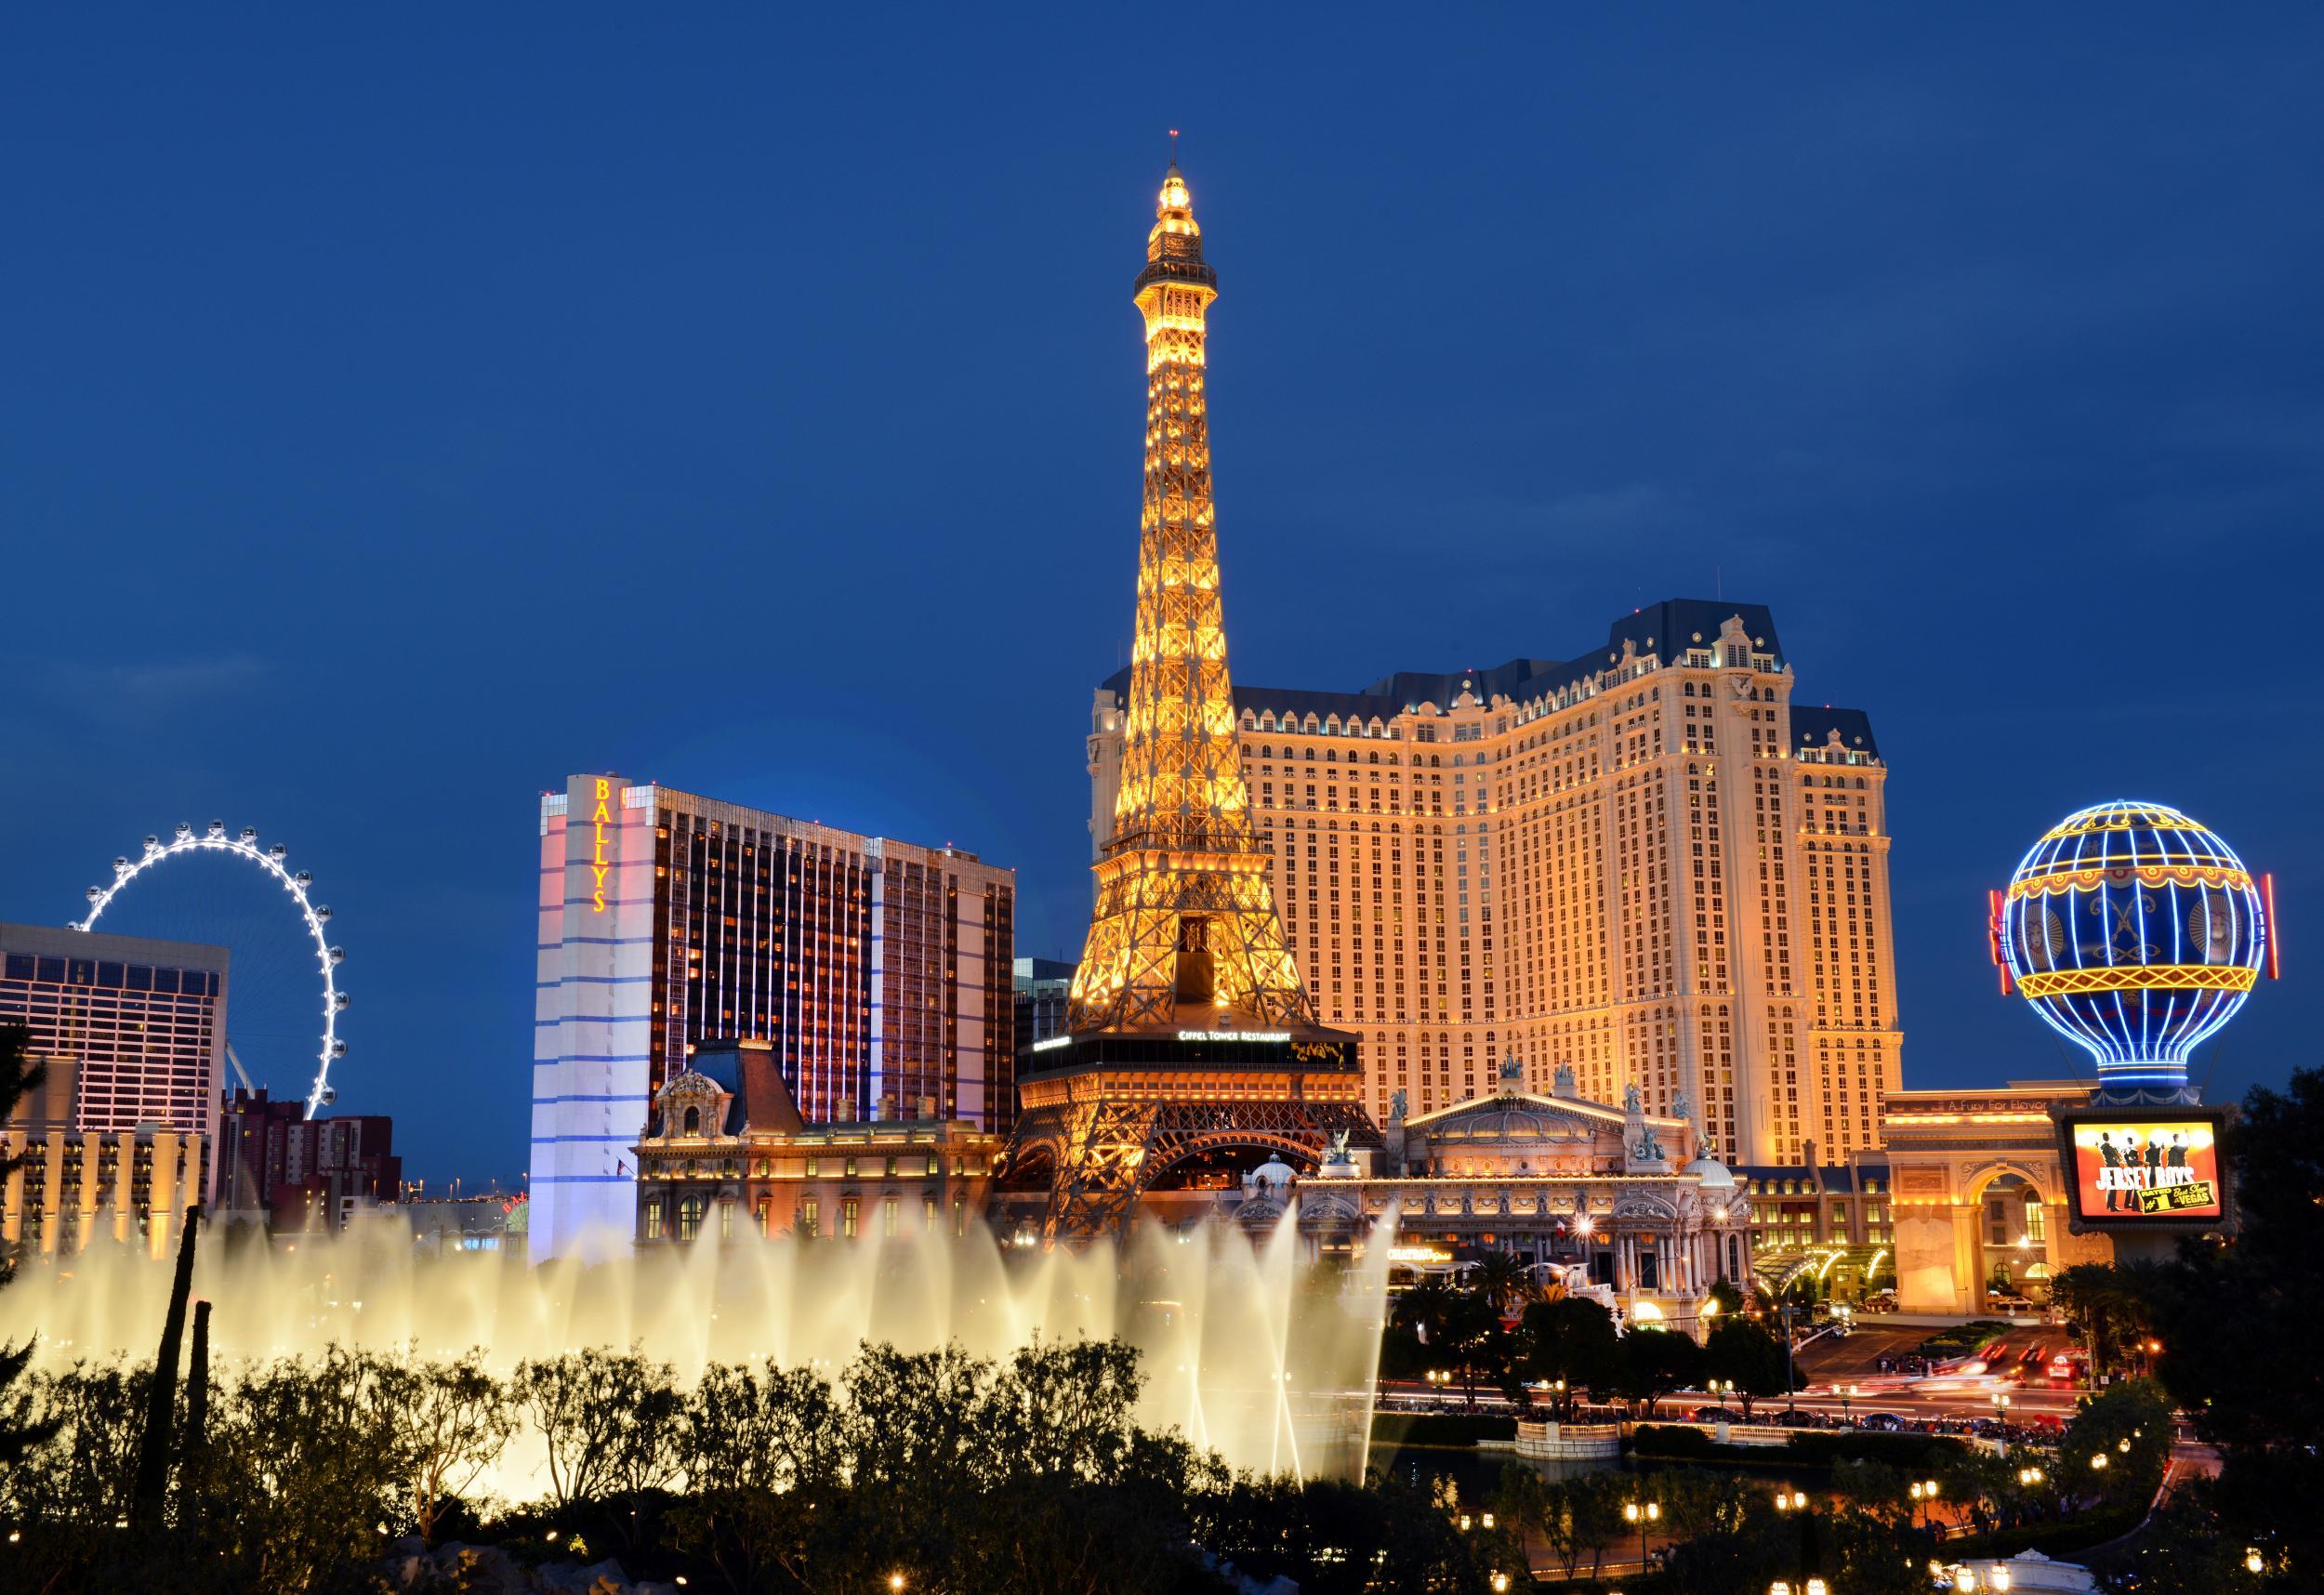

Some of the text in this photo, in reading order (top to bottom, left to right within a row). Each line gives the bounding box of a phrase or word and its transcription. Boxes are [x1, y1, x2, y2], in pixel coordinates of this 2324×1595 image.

[1208, 1031, 1238, 1041] TOWER
[1241, 1032, 1291, 1041] RESTAURANT
[1989, 1100, 2007, 1110] For
[2012, 1099, 2046, 1110] Flavor
[2096, 1166, 2195, 1190] JERSEY BOYS
[2142, 1188, 2172, 1197] RATED
[2179, 1193, 2210, 1205] VEGAS
